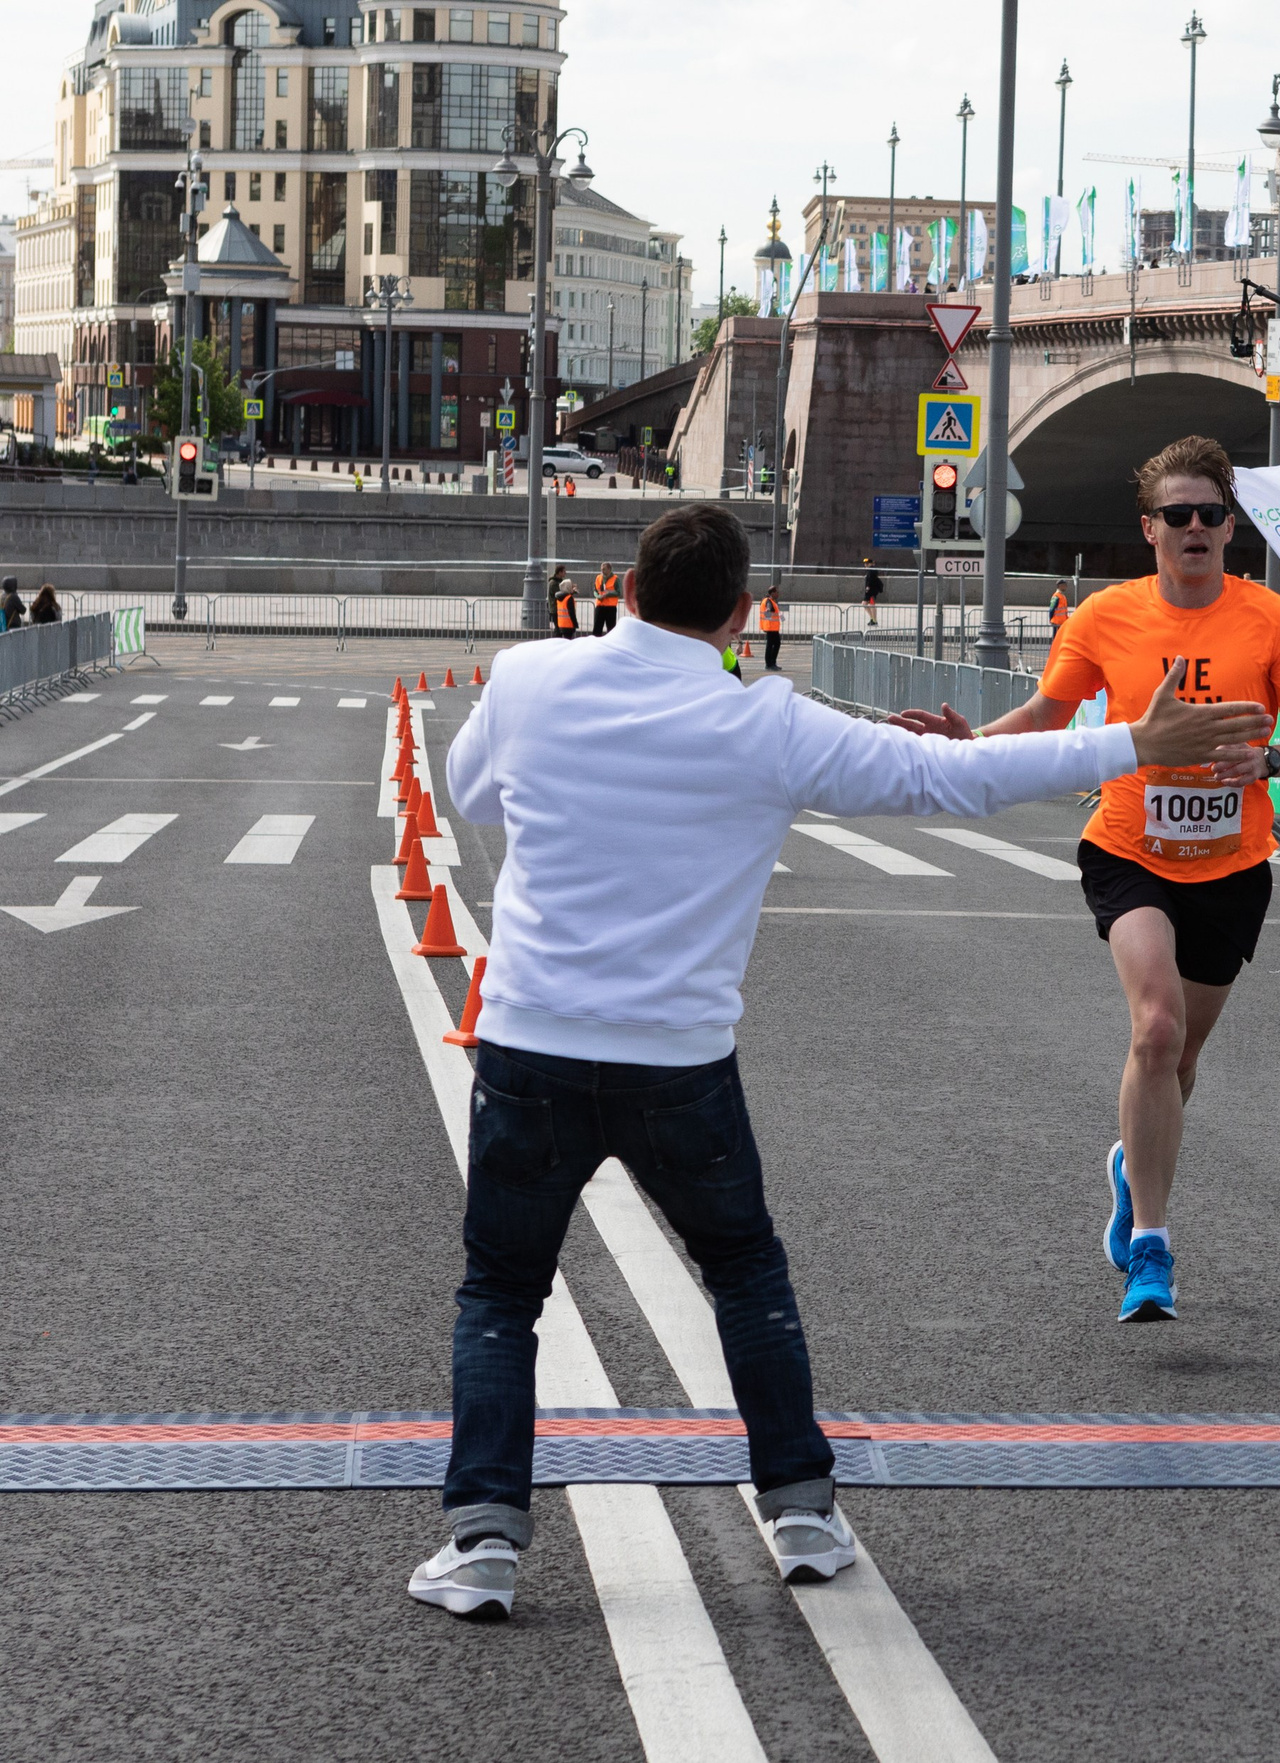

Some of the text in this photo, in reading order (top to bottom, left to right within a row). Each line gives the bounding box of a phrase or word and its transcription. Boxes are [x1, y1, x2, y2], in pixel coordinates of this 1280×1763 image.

[944, 560, 981, 573] СТОП
[1151, 792, 1239, 823] 10050
[1180, 825, 1212, 833] ПАВЕЛ
